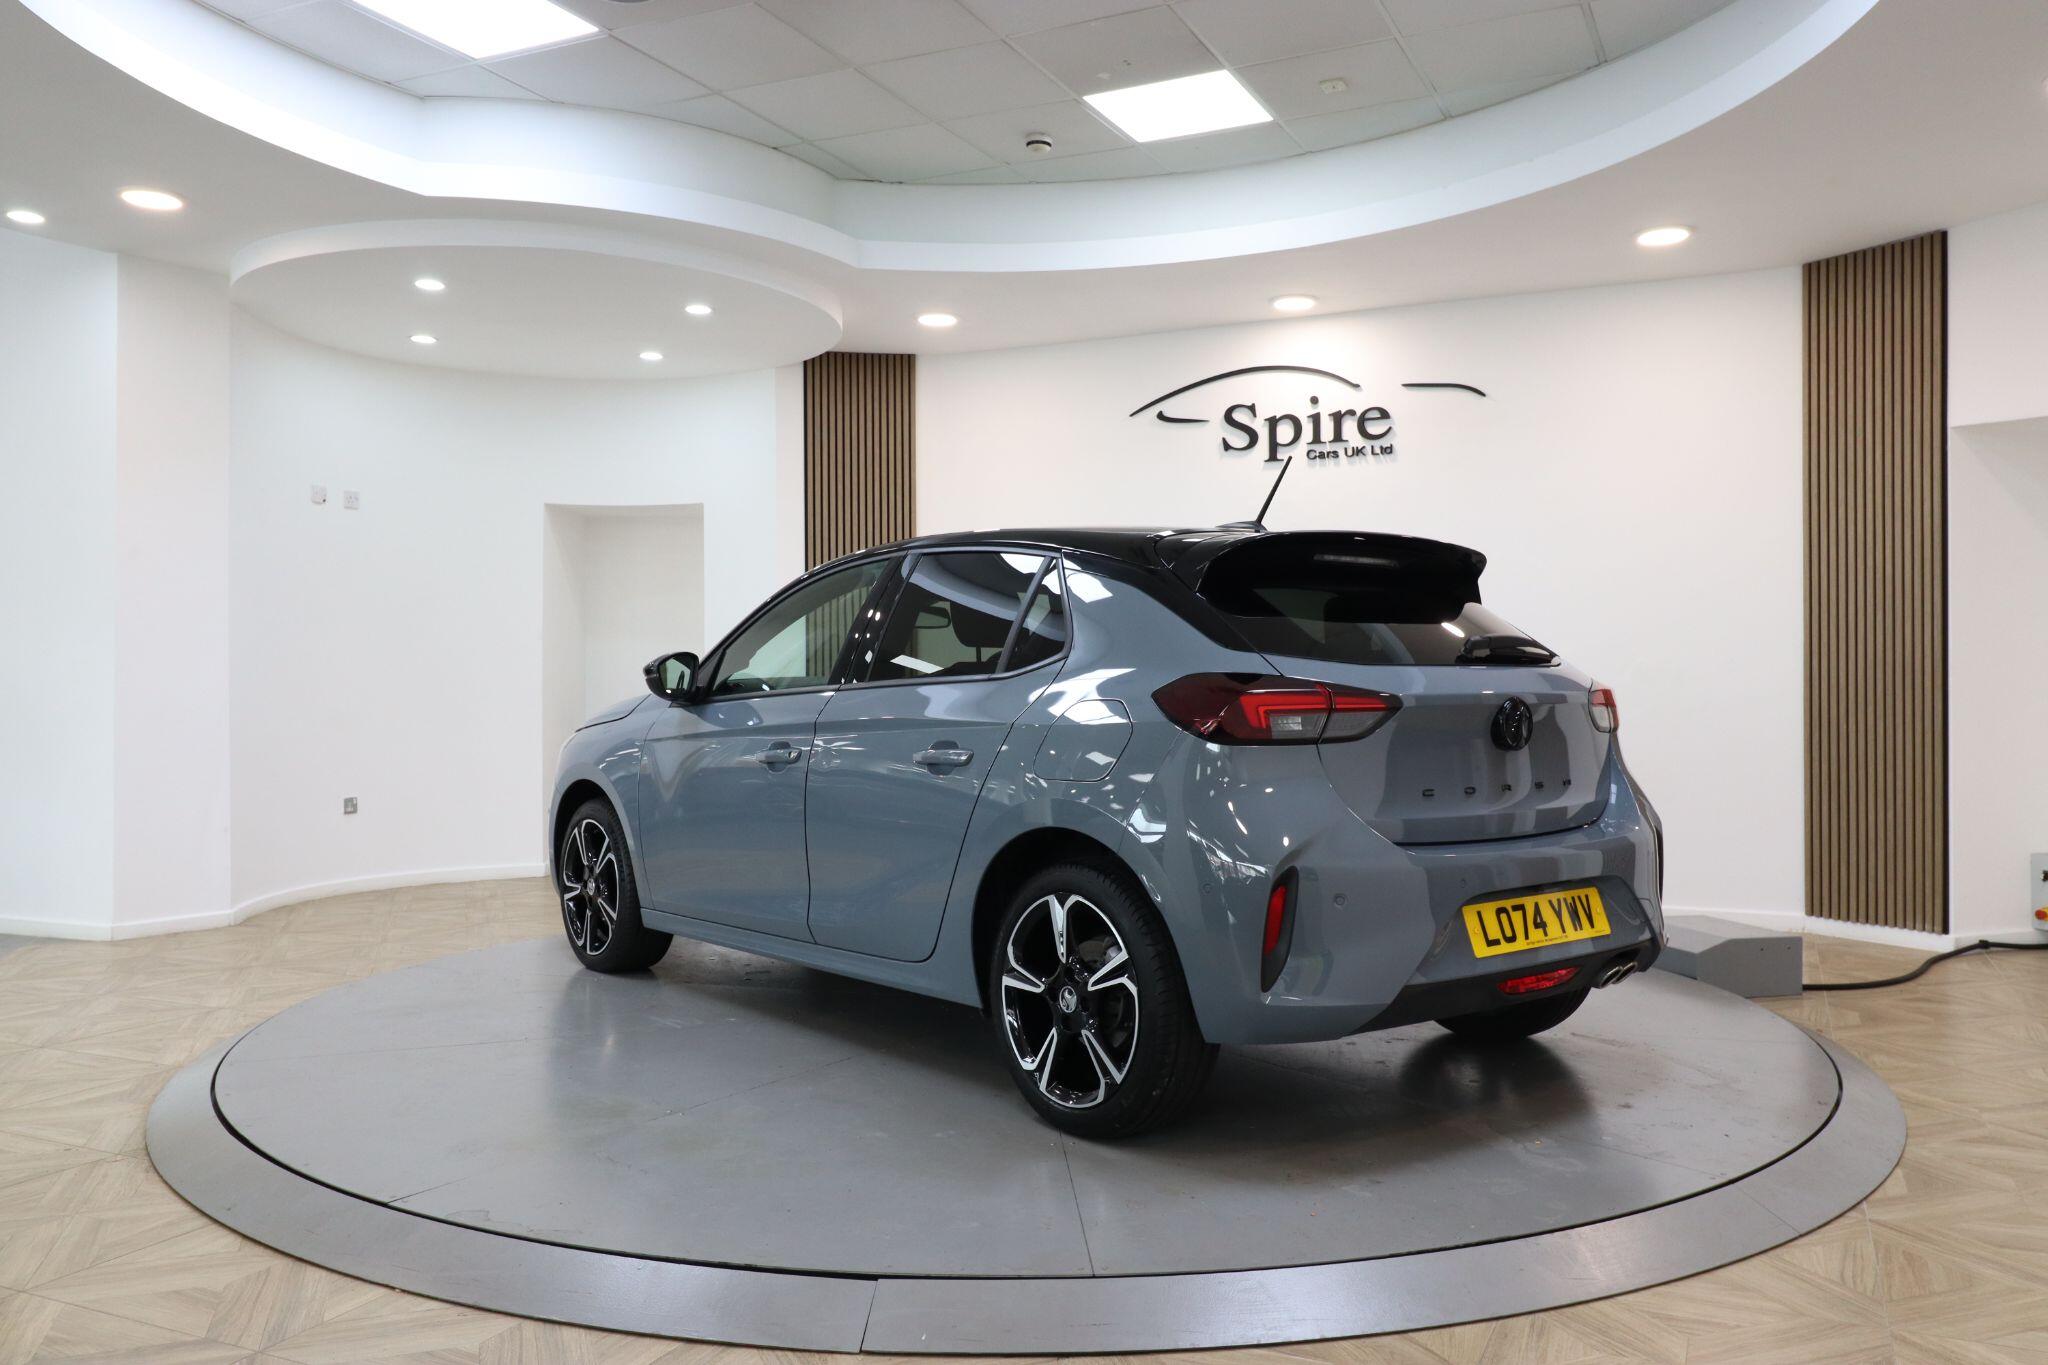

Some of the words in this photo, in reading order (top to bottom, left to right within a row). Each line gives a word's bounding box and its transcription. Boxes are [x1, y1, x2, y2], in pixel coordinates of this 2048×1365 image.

[1222, 395, 1392, 462] Spire
[1306, 449, 1339, 460] Cars
[1344, 445, 1366, 457] UK
[1371, 443, 1393, 456] Ltd
[1476, 900, 1548, 948] LO74
[1548, 893, 1595, 934] YWV
